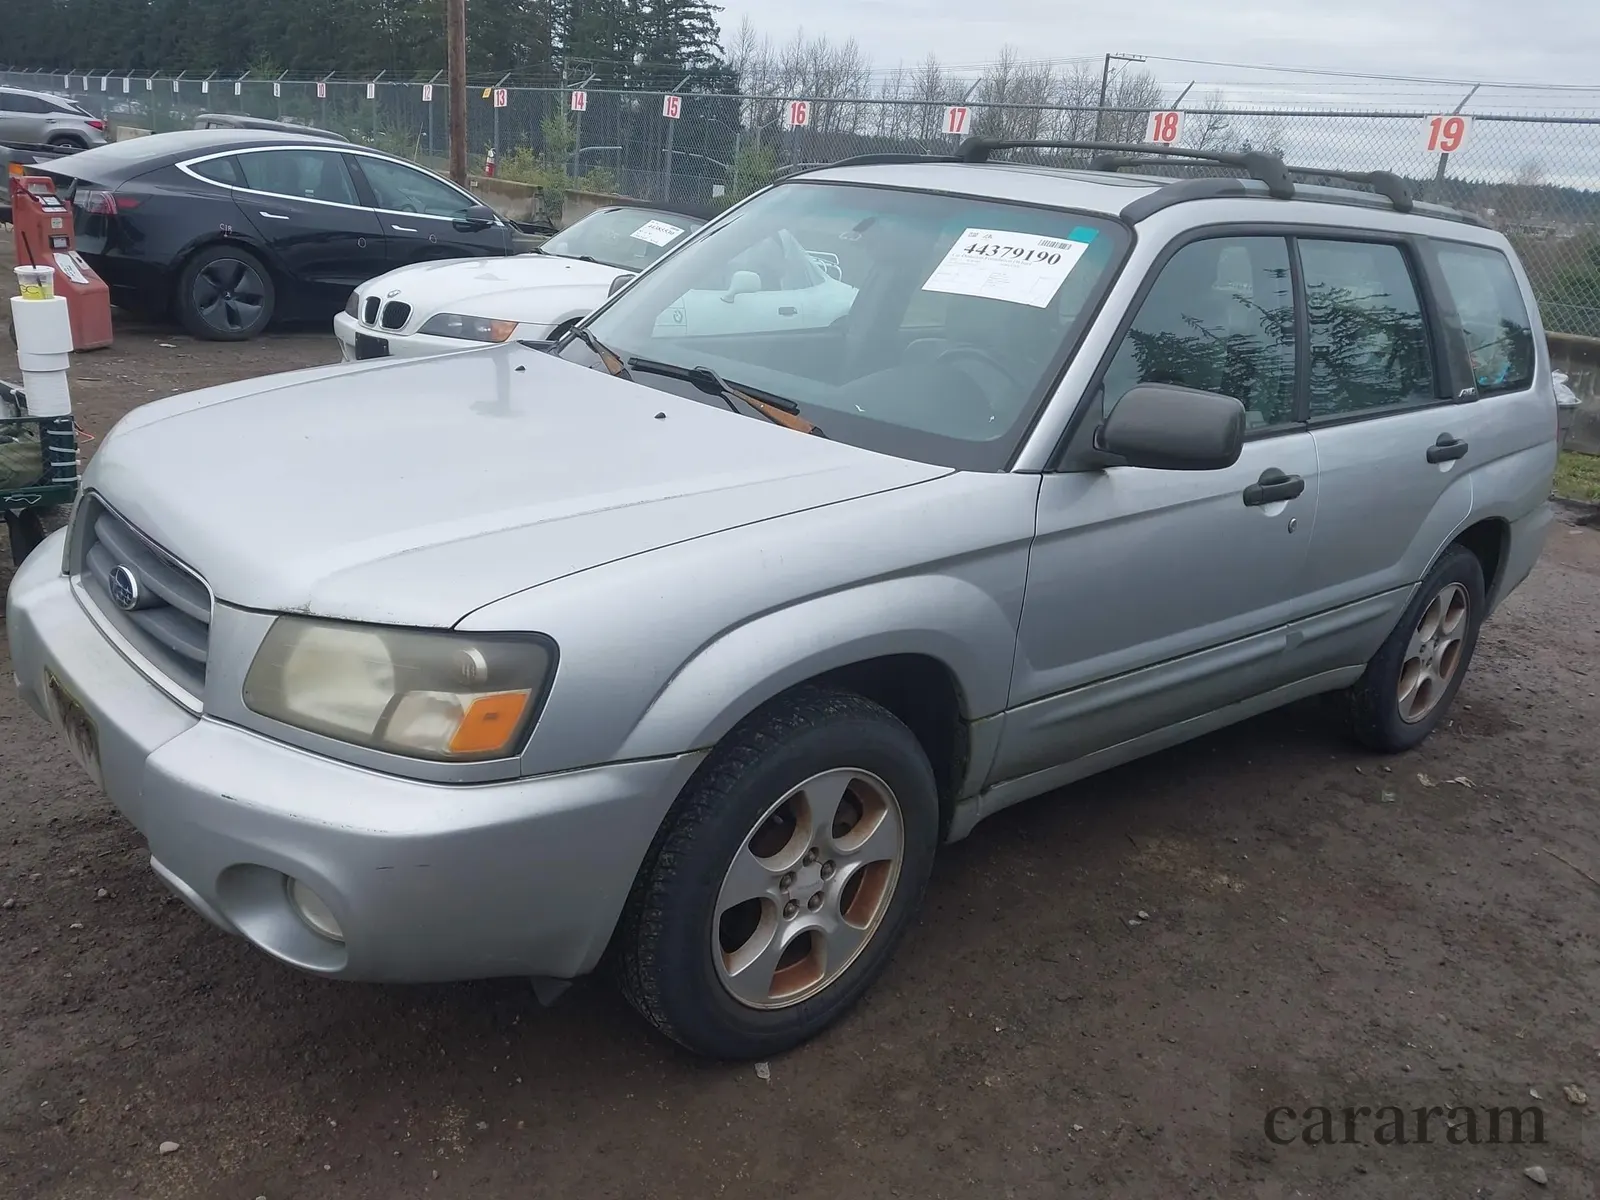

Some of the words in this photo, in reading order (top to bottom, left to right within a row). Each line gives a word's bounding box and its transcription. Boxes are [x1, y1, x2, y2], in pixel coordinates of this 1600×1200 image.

[424, 86, 431, 100] 12
[496, 90, 505, 106] 13
[574, 92, 584, 110] 14
[666, 96, 679, 117] 15
[790, 102, 806, 125] 16
[949, 107, 967, 133] 17
[1153, 112, 1179, 142] 18
[1427, 117, 1465, 152] 19
[963, 243, 1062, 266] 44379190
